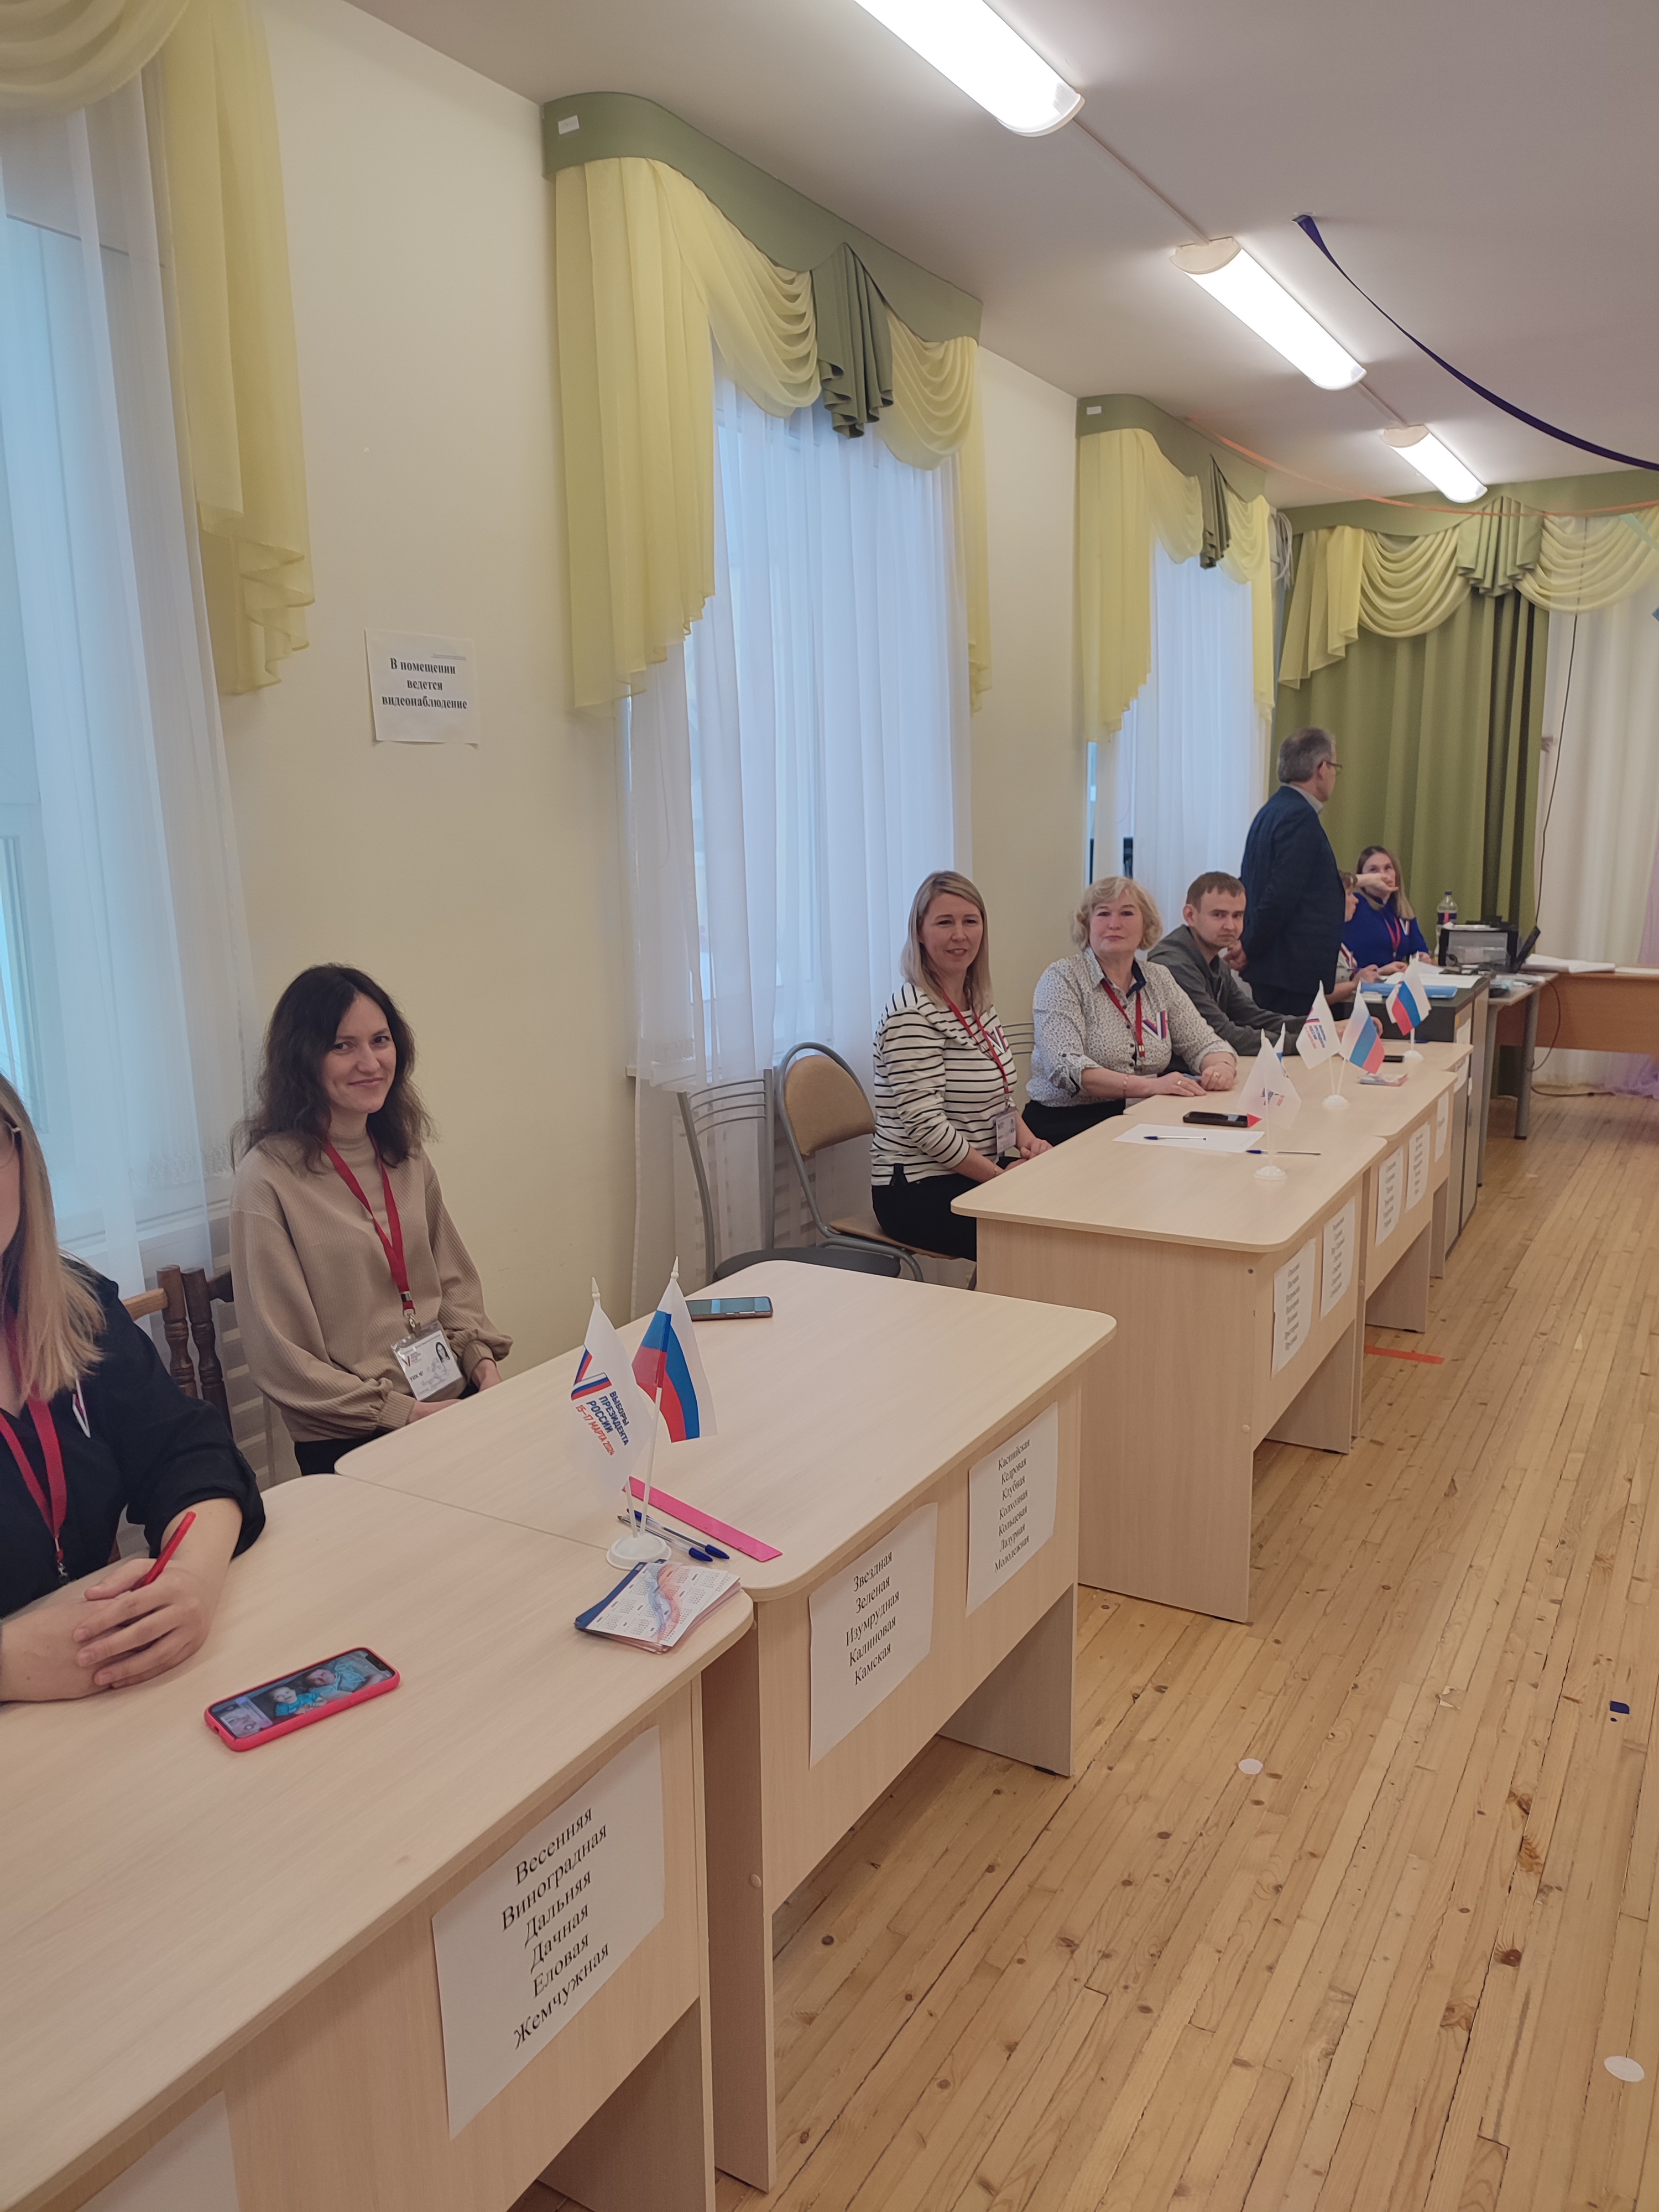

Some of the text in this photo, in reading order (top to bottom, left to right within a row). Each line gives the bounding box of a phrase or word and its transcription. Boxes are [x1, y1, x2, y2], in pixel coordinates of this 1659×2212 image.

[390, 658, 456, 674] В помещении
[406, 680, 443, 691] ведется
[382, 695, 467, 709] видеонаблюдение
[586, 1400, 613, 1433] РОССИИ
[599, 1395, 629, 1446] ПРЕЗИДЕНТА
[609, 1391, 630, 1426] ВЫБОРЫ
[588, 1421, 607, 1442] МАРТА
[998, 1439, 1030, 1470] Каспийская
[1001, 1457, 1027, 1485] Кедровая
[999, 1489, 1028, 1520] Колхозная
[1001, 1475, 1025, 1501] Клубная
[999, 1524, 1025, 1553] Лазурная
[853, 1551, 893, 1593] Звездная
[855, 1575, 890, 1614] Зеленая
[846, 1590, 900, 1647] Изумрудная
[849, 1615, 896, 1667] Калиновая
[854, 1642, 891, 1686] Камская
[514, 1807, 592, 1886] Весенняя
[501, 1824, 607, 1932] Виноградная
[524, 1870, 592, 1949] Дальняя
[530, 1903, 589, 1975] Дачная
[532, 1933, 589, 1999] Еловая
[513, 1943, 609, 2051] Жемчужная
